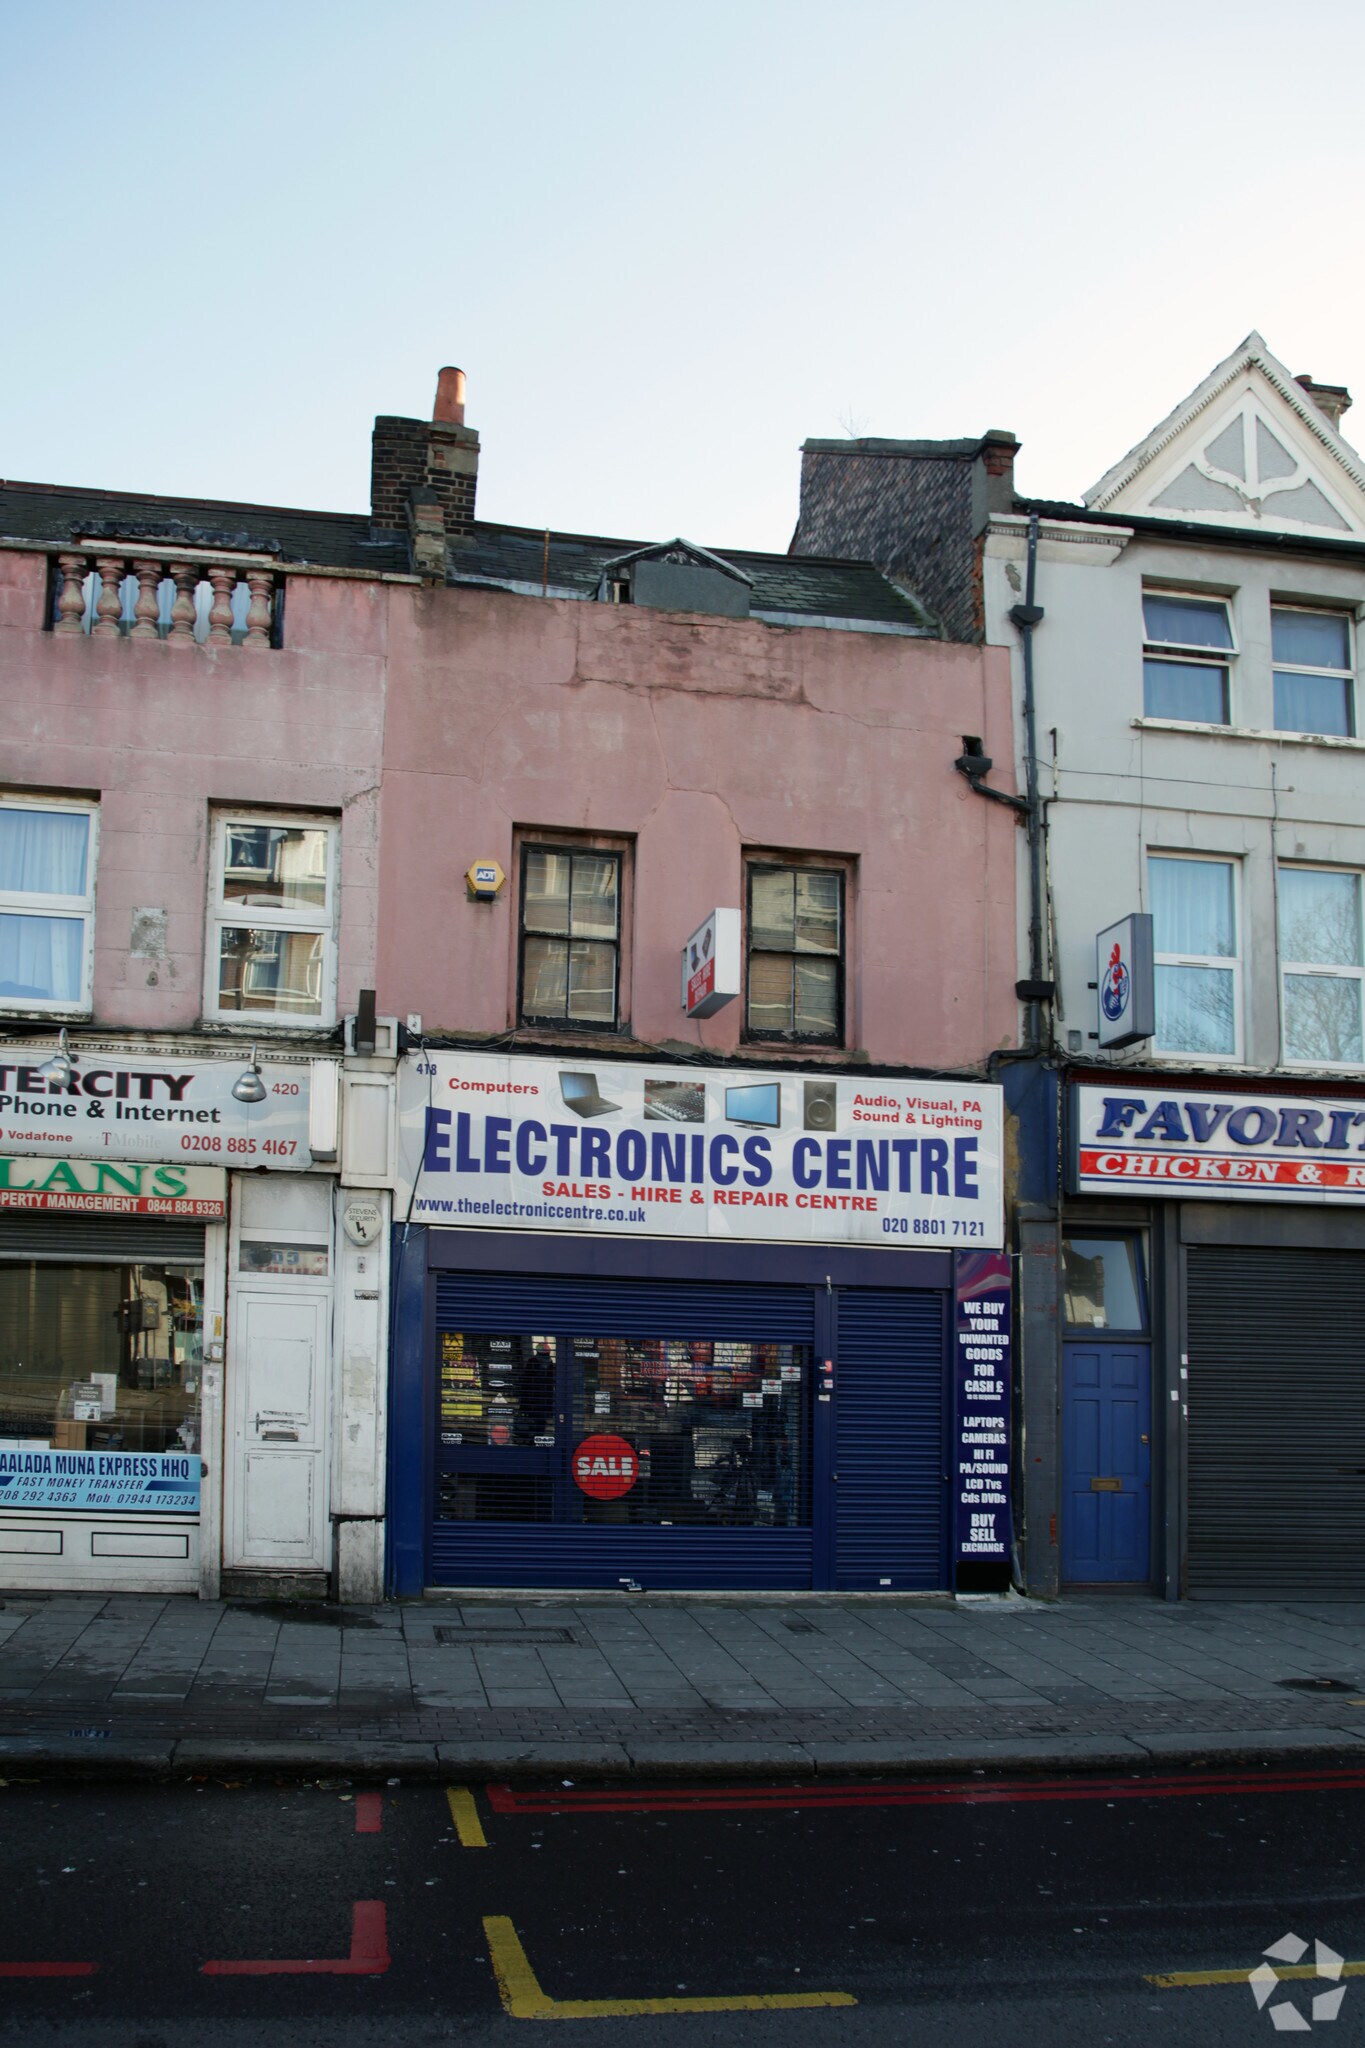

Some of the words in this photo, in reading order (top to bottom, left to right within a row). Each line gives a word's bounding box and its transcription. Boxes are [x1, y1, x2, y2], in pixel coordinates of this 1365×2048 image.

[477, 871, 496, 880] ADT
[416, 1063, 437, 1076] 418
[272, 1082, 299, 1096] 420
[449, 1077, 539, 1095] Computers
[0, 1094, 77, 1117] Phone
[86, 1099, 105, 1119] &
[116, 1101, 221, 1124] Internet
[853, 1094, 901, 1110] Audio,
[906, 1097, 957, 1113] Visual,
[962, 1101, 982, 1113] PA
[852, 1109, 900, 1124] Sound
[905, 1112, 917, 1125] &
[922, 1113, 983, 1131] Lighting
[1096, 1097, 1365, 1151] FAVORI
[8, 1130, 73, 1143] Vodafone
[181, 1134, 221, 1152] 0208
[227, 1137, 257, 1154] 885
[262, 1139, 298, 1156] 4167
[423, 1106, 773, 1187] ELECTRONICS
[792, 1136, 979, 1200] CENTRE
[1096, 1153, 1281, 1182] CHICKEN
[1296, 1164, 1323, 1184] &
[0, 1158, 188, 1198] LANS
[542, 1181, 611, 1199] SALES
[631, 1186, 682, 1204] HIRE
[690, 1189, 705, 1205] &
[713, 1189, 789, 1208] REPAIR
[795, 1193, 878, 1212] CENTRE
[47, 1194, 139, 1212] MANAGEMENT
[147, 1199, 172, 1213] 0844
[175, 1200, 194, 1214] 884
[196, 1201, 221, 1216] 9326
[348, 1207, 377, 1215] STEVENS
[415, 1197, 646, 1222] www.theelectroniccentre.co.uk
[882, 1217, 908, 1233] 020
[913, 1218, 946, 1235] 8801
[952, 1220, 985, 1237] 7121
[963, 1301, 982, 1315] WE
[983, 1302, 1005, 1315] BUY
[969, 1318, 999, 1331] YOUR
[959, 1333, 1009, 1345] UNWANTED
[965, 1347, 1003, 1361] GOODS
[973, 1364, 995, 1377] FOR
[964, 1380, 994, 1393] CASH
[995, 1380, 1004, 1393] £
[963, 1416, 1005, 1428] LAPTOPS
[961, 1432, 1006, 1444] CAMERAS
[973, 1449, 984, 1460] HI
[985, 1449, 994, 1460] FI
[0, 1454, 52, 1474] AALADA
[55, 1455, 95, 1475] MUNA
[99, 1457, 157, 1477] EXPRESS
[161, 1458, 190, 1480] HHQ
[576, 1456, 633, 1476] SALE
[959, 1462, 1008, 1475] PA/SOUND
[16, 1476, 44, 1487] FAST
[47, 1478, 86, 1488] MONEY
[88, 1479, 144, 1490] TRANSFER
[965, 1478, 984, 1490] LCD
[0, 1489, 19, 1501] 208
[23, 1491, 43, 1502] 292
[48, 1492, 77, 1502] 4363
[86, 1493, 113, 1504] Mob:
[117, 1494, 152, 1505] 07944
[156, 1495, 196, 1506] 173234
[961, 1492, 980, 1504] Cds
[981, 1492, 1006, 1504] DVDs
[971, 1513, 996, 1527] BUY
[970, 1528, 996, 1542] SELL
[961, 1542, 1004, 1553] EXCHANGE
